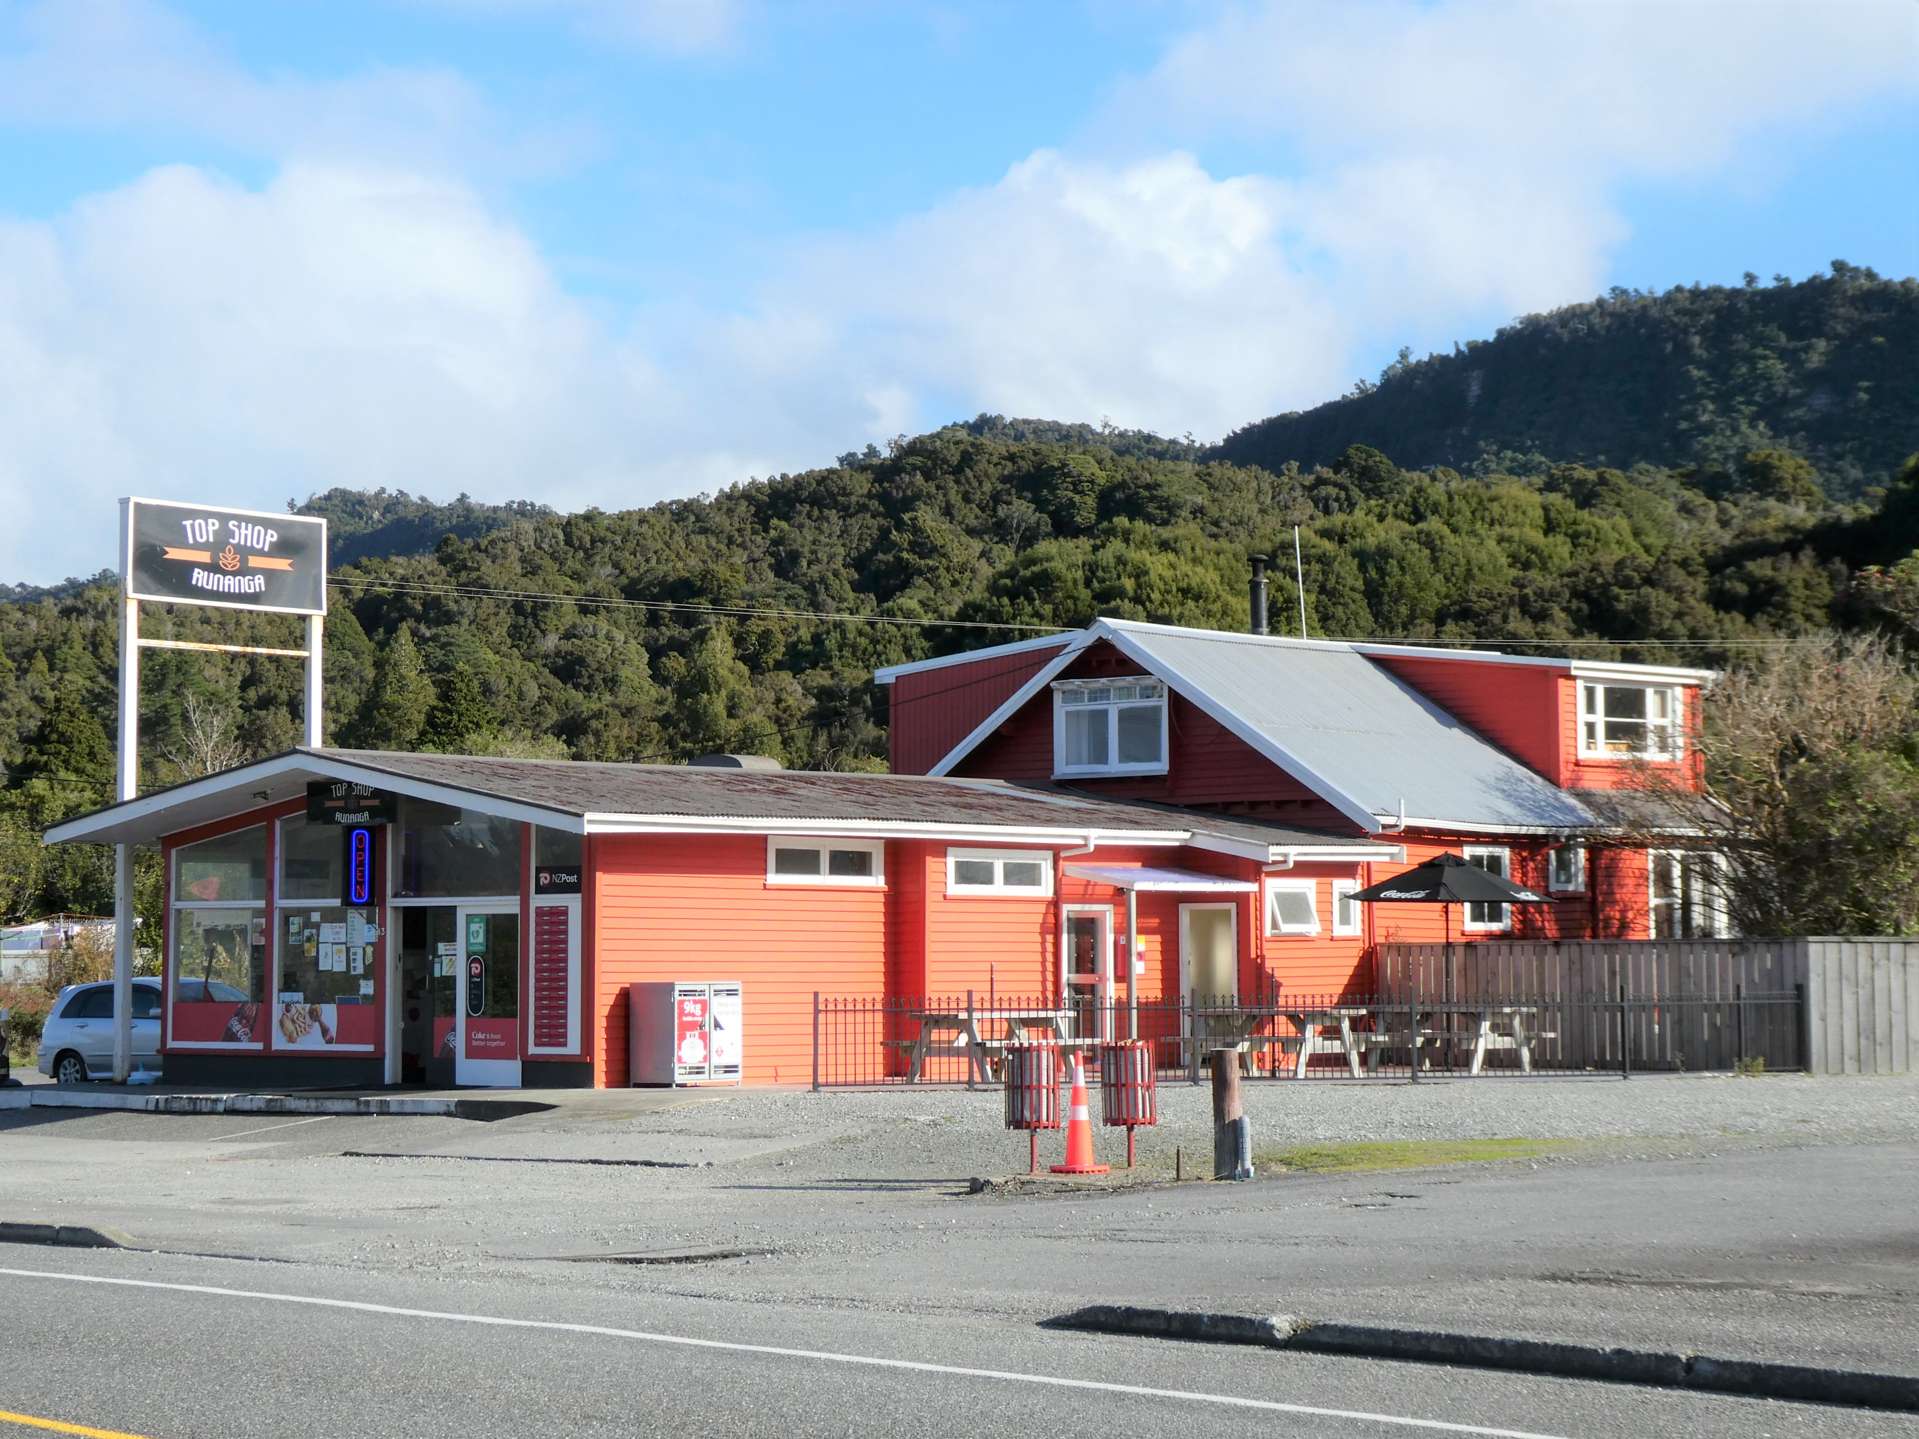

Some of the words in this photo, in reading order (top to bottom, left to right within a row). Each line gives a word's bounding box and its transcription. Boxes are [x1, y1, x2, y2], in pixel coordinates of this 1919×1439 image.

[181, 518, 219, 544] TOP
[228, 520, 278, 552] SHOP
[191, 568, 266, 594] RUNANGA
[330, 782, 348, 798] TOP
[352, 782, 375, 797] SHOP
[335, 811, 370, 823] RUNANGA
[683, 1000, 702, 1017] 9kg
